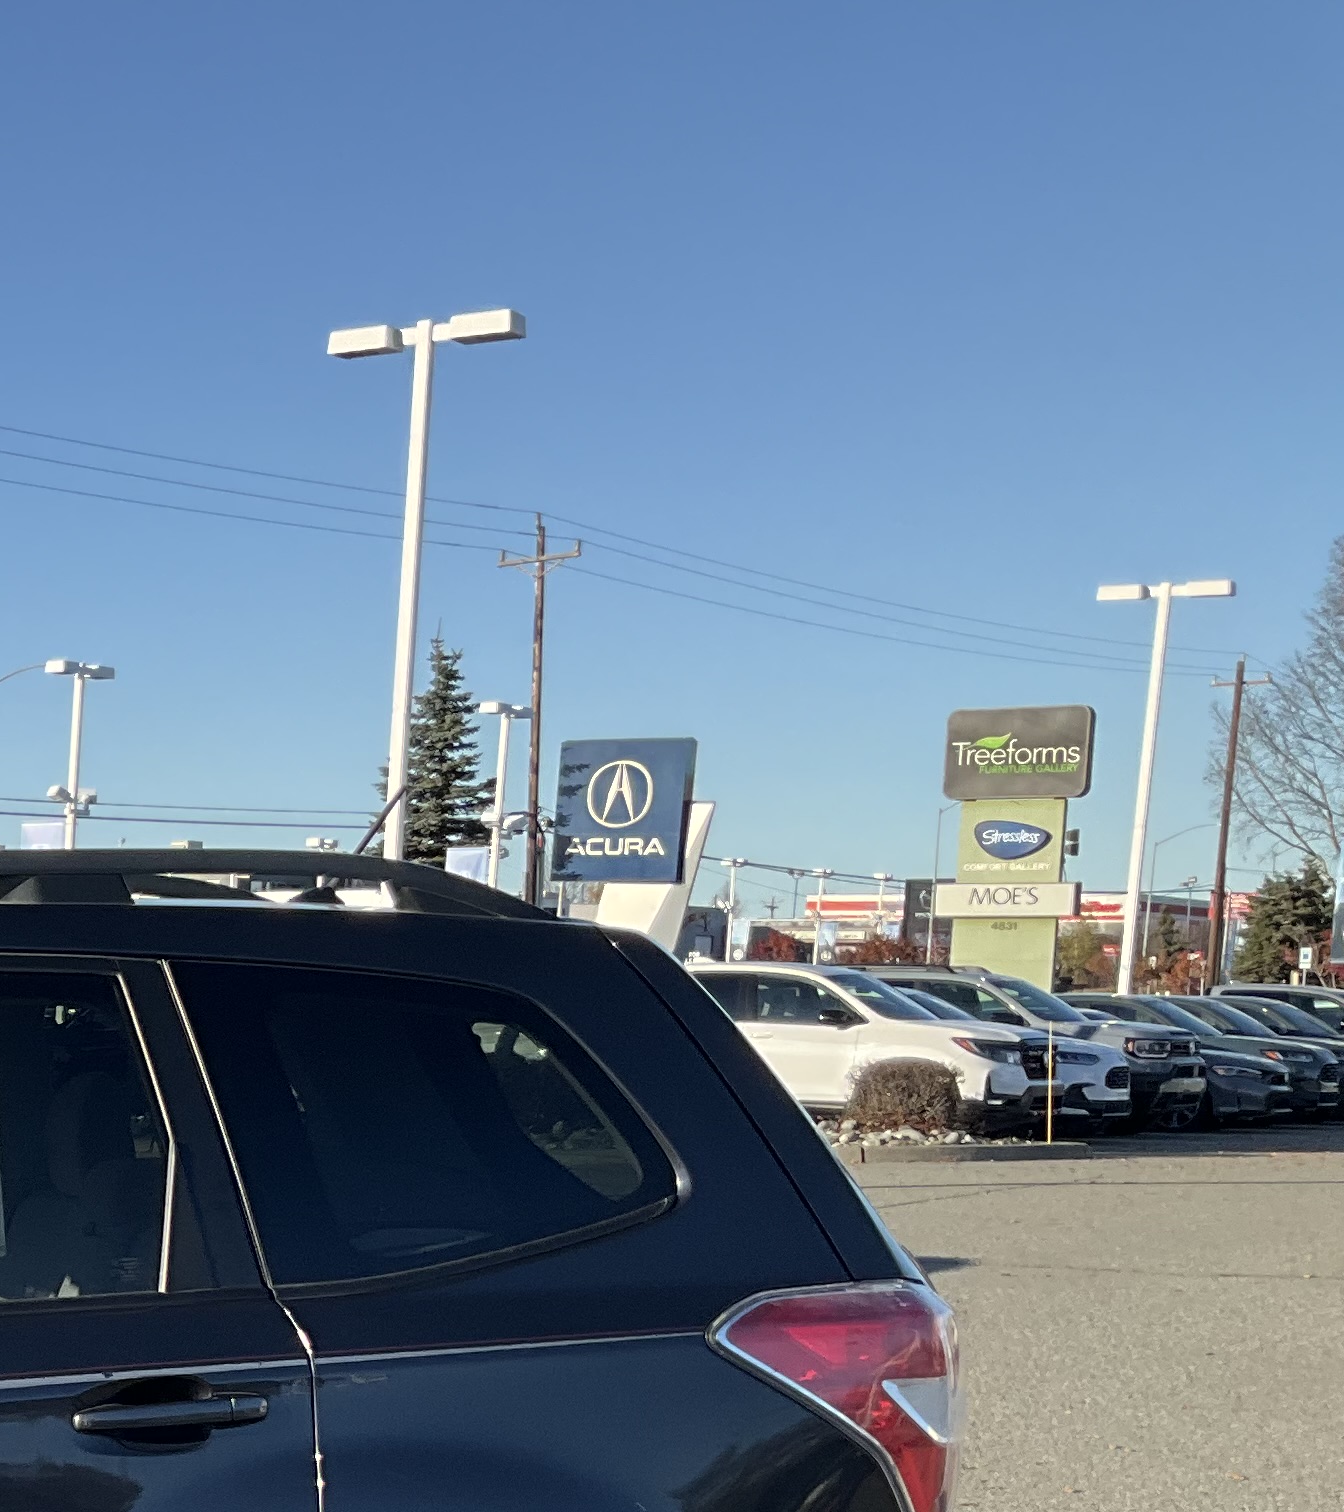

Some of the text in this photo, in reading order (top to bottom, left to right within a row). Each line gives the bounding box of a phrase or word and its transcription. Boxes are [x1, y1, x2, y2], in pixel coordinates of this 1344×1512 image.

[951, 738, 1081, 766] Treeforms
[979, 763, 1079, 774] FURNITURE GALLERY
[981, 829, 1041, 845] Stressless
[564, 837, 665, 856] ACURA
[1008, 862, 1051, 871] GALLERY
[968, 886, 1039, 905] MOE'S
